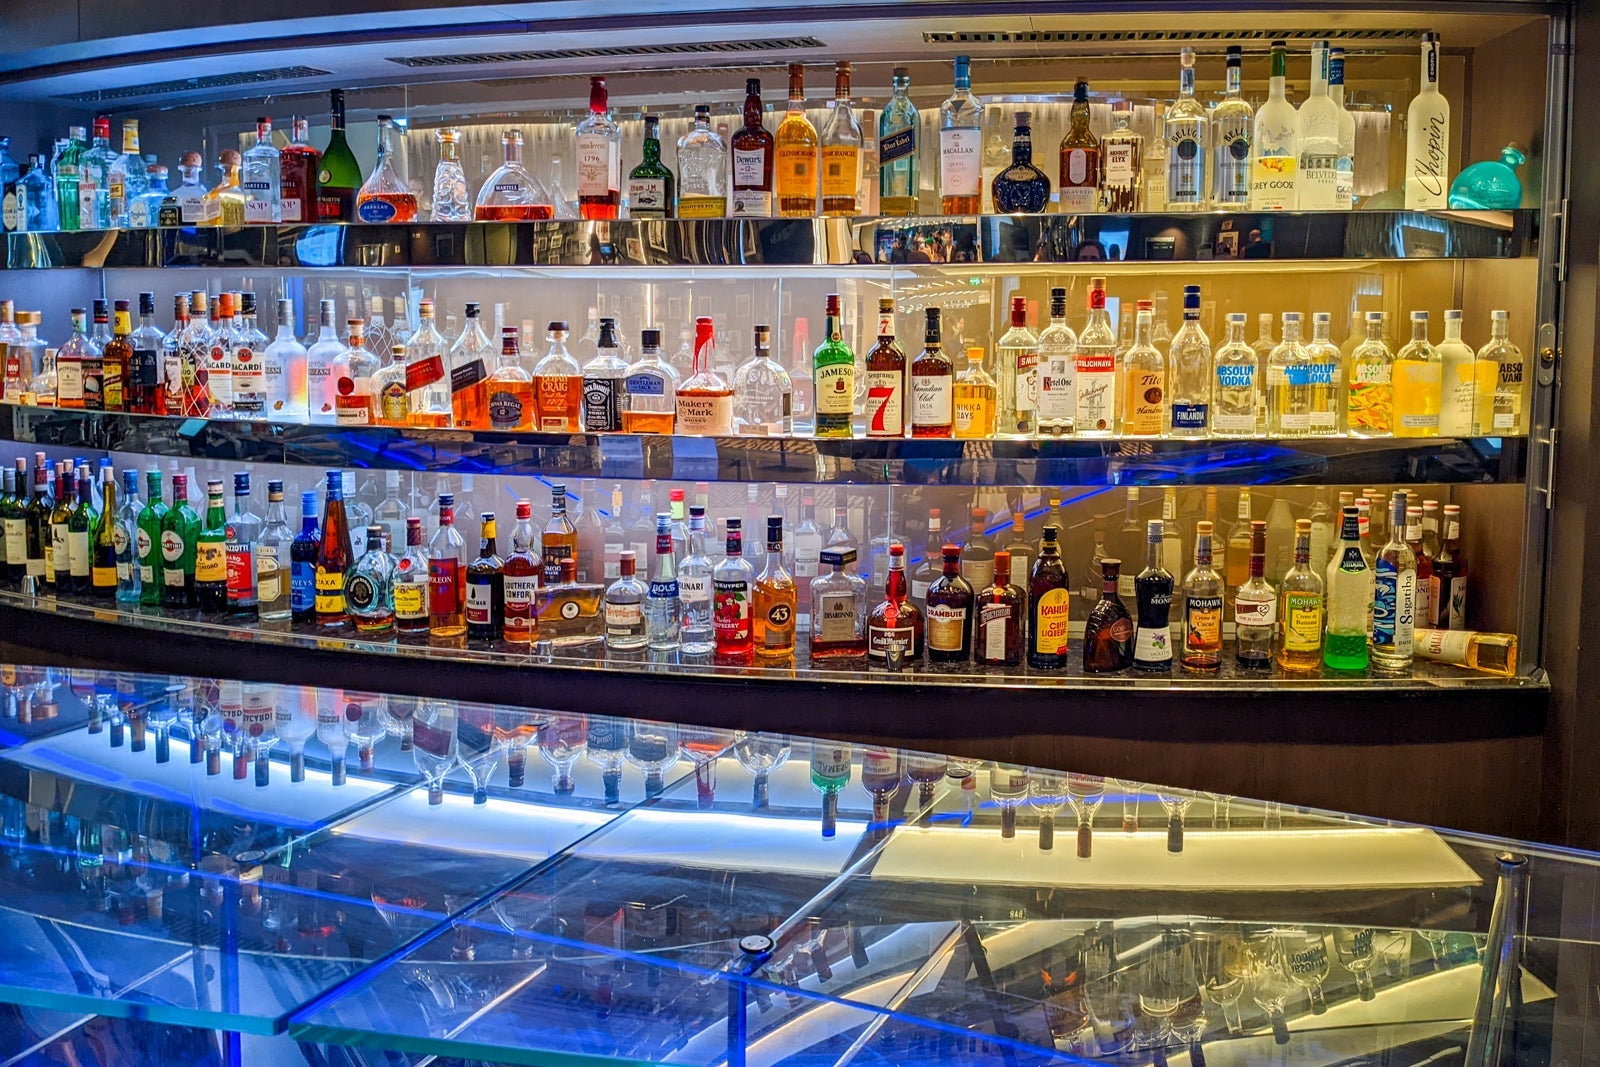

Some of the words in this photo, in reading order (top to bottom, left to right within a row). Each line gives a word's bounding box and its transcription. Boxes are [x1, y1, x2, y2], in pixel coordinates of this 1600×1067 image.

[942, 147, 974, 155] MACALLAN
[1415, 113, 1446, 196] Chopin
[736, 155, 762, 164] Dewar's
[1253, 181, 1268, 190] GREY
[1269, 180, 1294, 189] GOOSE
[879, 319, 890, 333] 7
[820, 367, 853, 379] JAMESO
[1217, 365, 1254, 375] ABSOLUT
[1043, 378, 1060, 389] Ketel
[1060, 378, 1072, 388] One
[1219, 376, 1251, 386] VODKA
[541, 382, 568, 392] CRAIG
[912, 382, 943, 392] Canadian
[678, 400, 713, 408] Maker's
[867, 386, 896, 431] 7
[956, 403, 981, 411] NIKKA
[359, 410, 367, 418] 8
[956, 412, 974, 420] DAYS
[1176, 411, 1205, 421] FINLANDIA
[504, 582, 535, 591] SOUTHERN
[652, 583, 676, 594] BOLS
[1189, 598, 1222, 608] MOHAWK
[1399, 575, 1414, 625] Sagatiba
[771, 608, 788, 621] 43
[927, 608, 963, 618] DRAMBUIE
